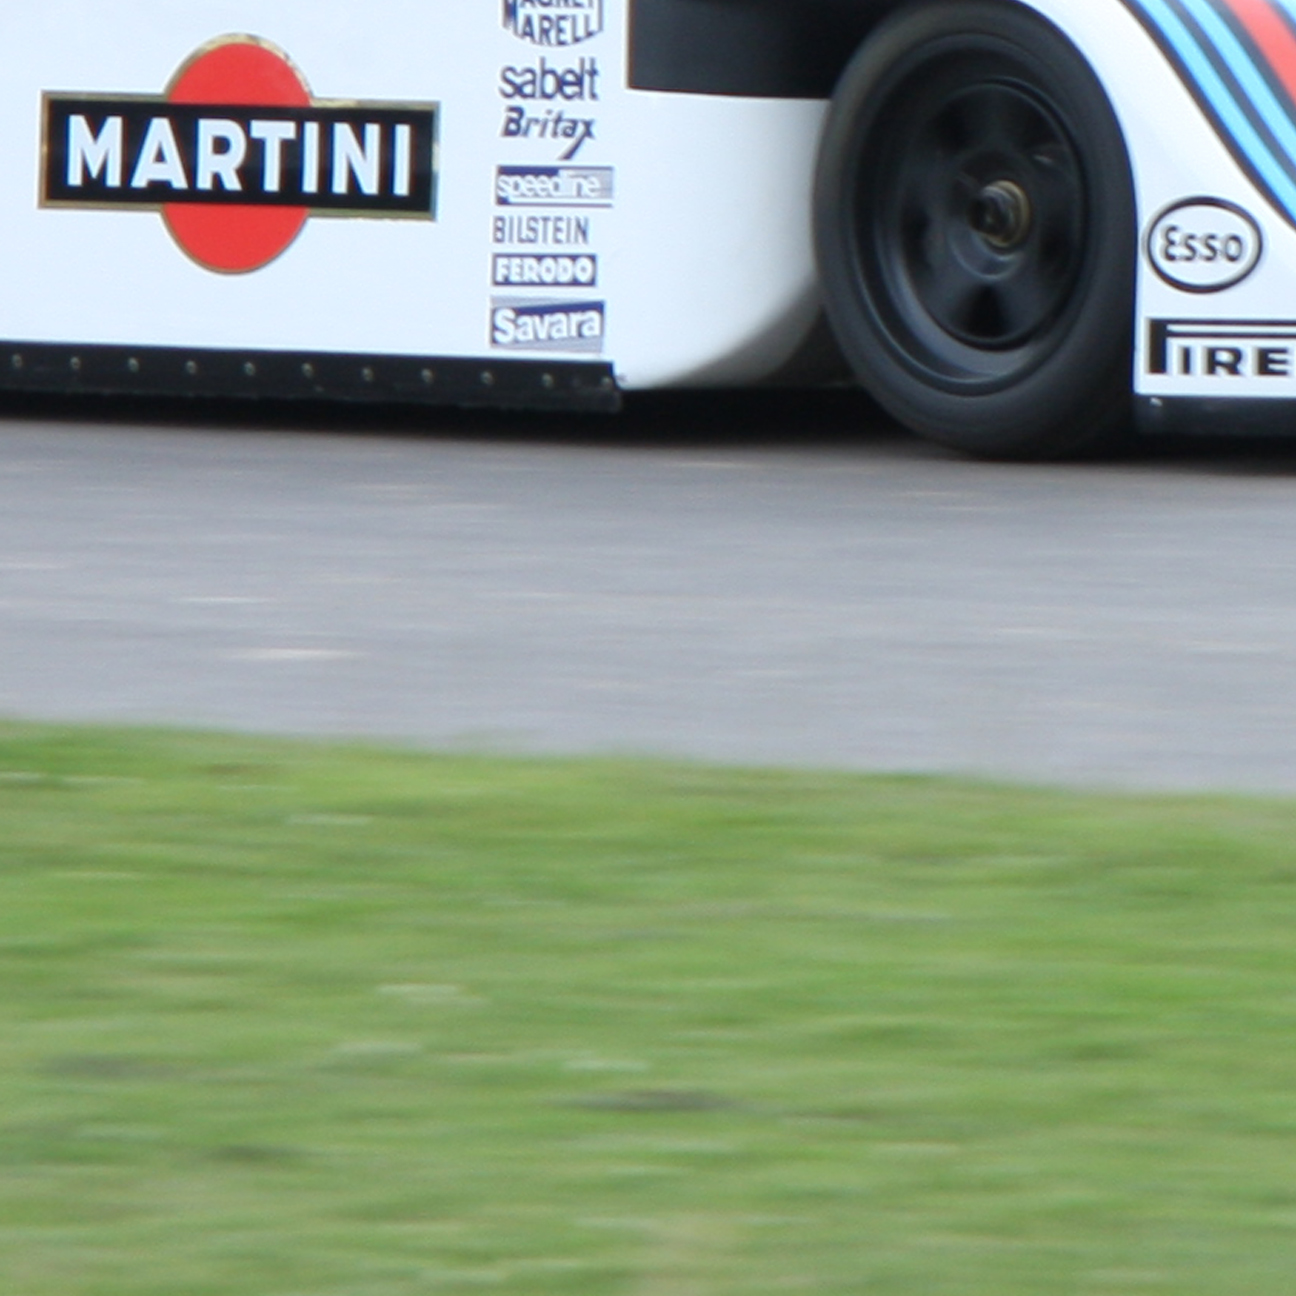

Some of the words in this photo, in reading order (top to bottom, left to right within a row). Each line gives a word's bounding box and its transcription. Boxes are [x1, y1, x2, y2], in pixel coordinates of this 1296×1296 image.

[499, 57, 599, 100] sabelt
[501, 105, 596, 161] Britax
[66, 114, 412, 197] MARTINI
[493, 215, 590, 244] BILSTEIN
[495, 256, 595, 283] FERODO
[493, 307, 602, 344] Savara
